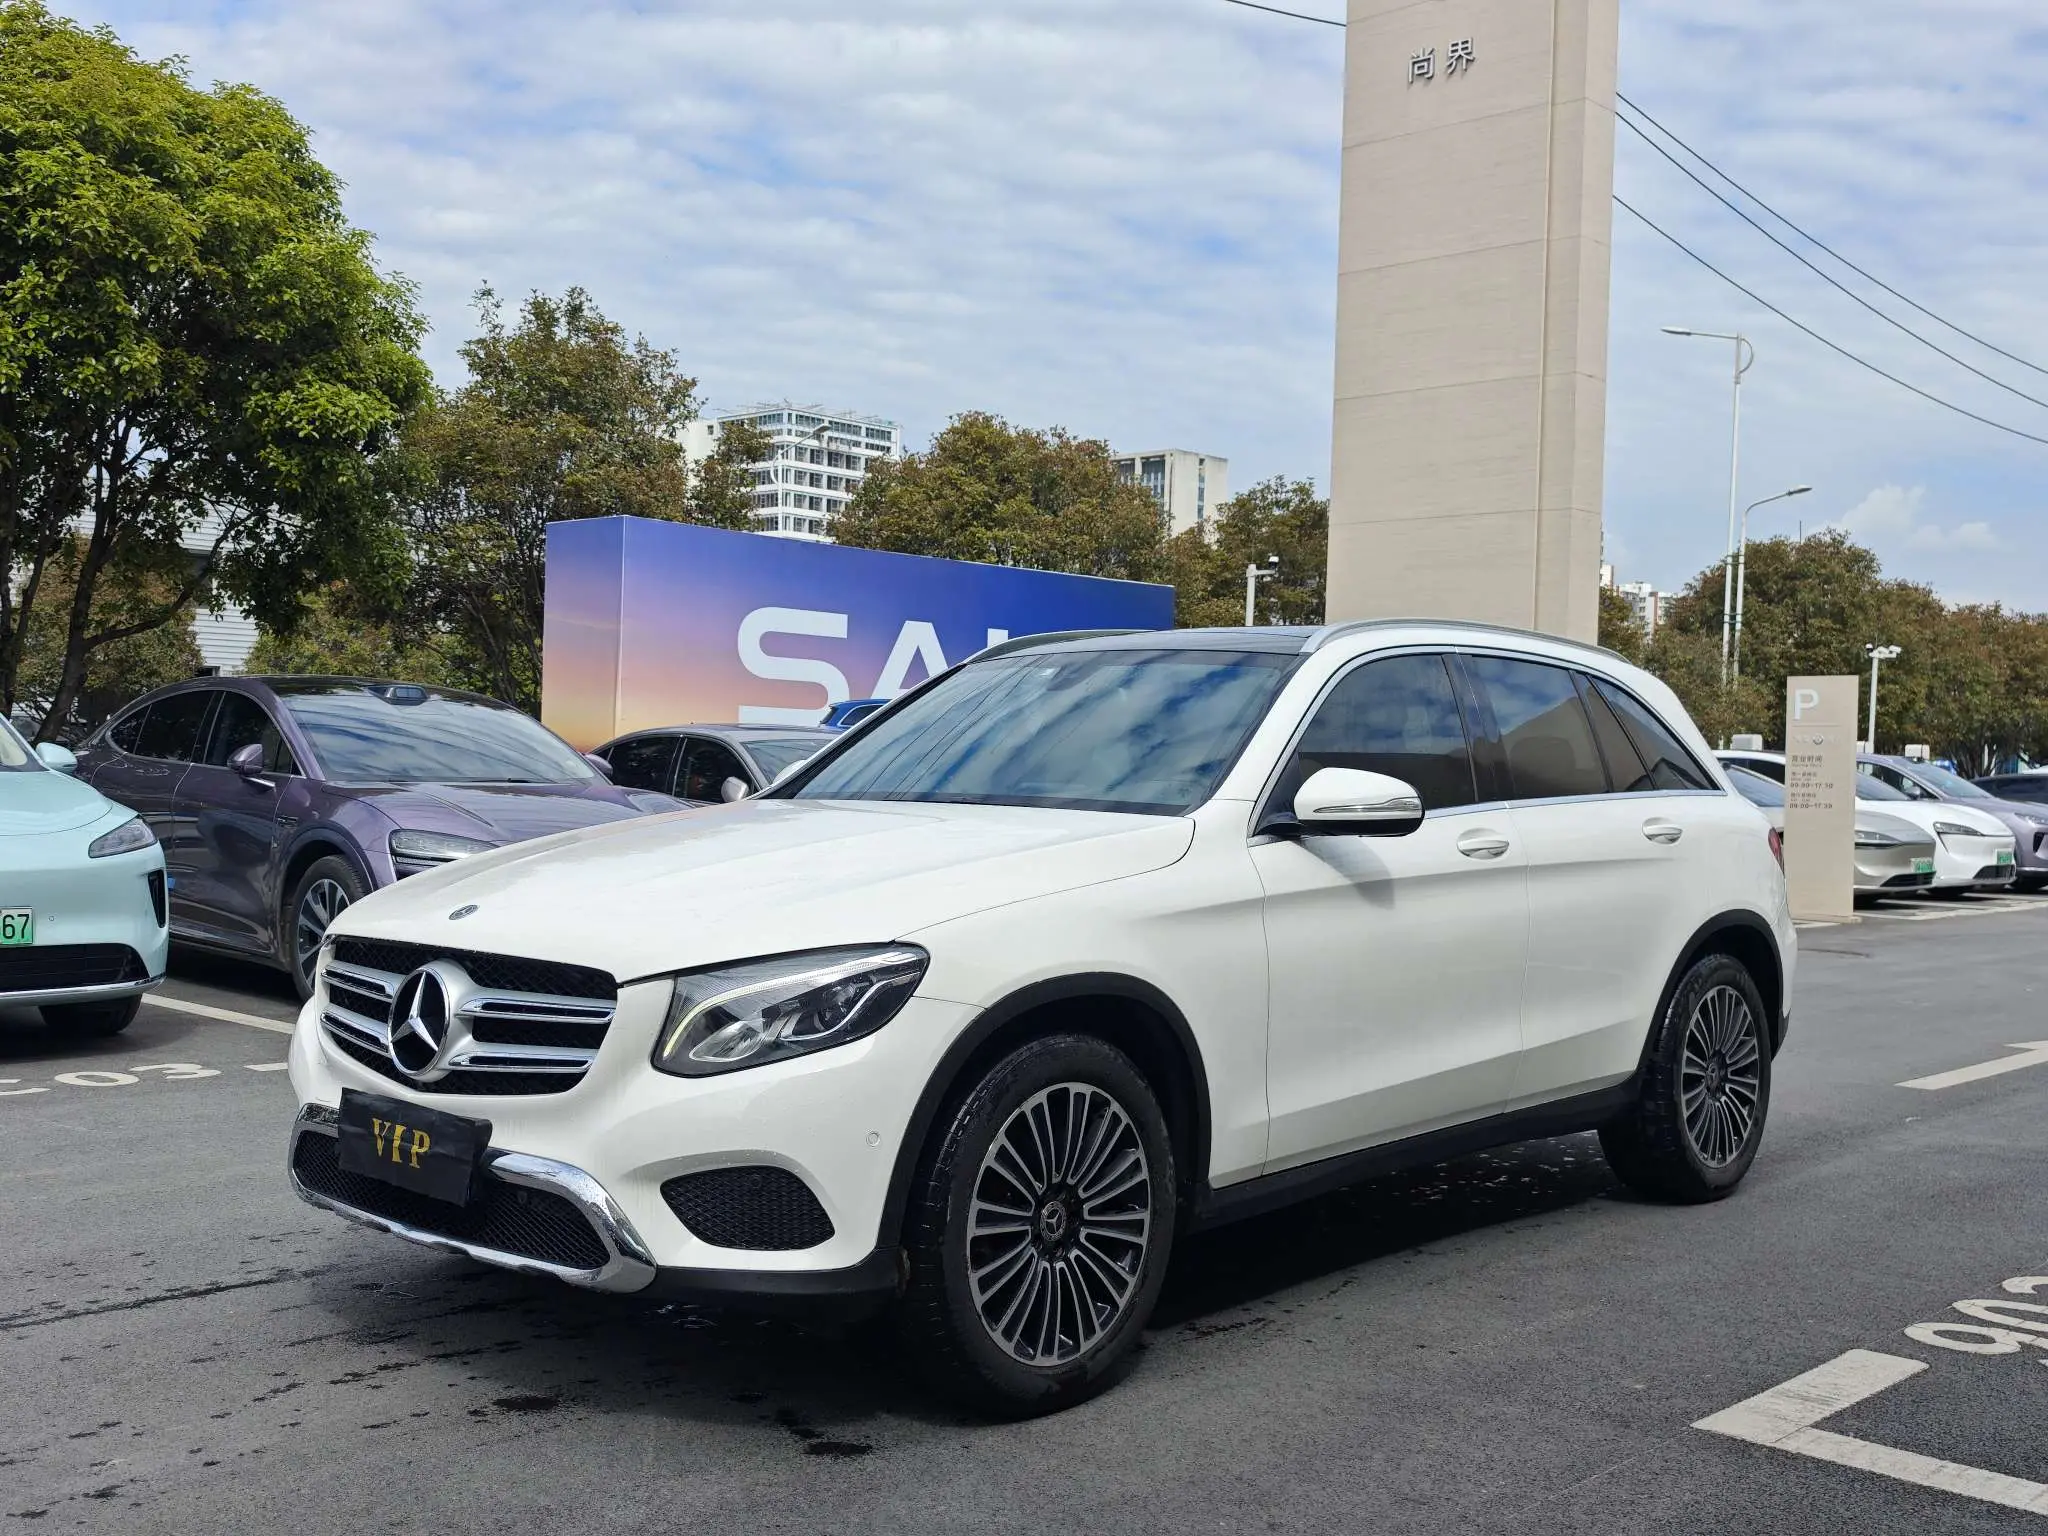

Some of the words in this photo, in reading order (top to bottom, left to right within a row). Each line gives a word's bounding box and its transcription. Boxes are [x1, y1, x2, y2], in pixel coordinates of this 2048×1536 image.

[1408, 37, 1476, 84] 尚界
[737, 606, 1009, 725] SA
[1793, 688, 1819, 720] P
[372, 1118, 432, 1169] VIP
